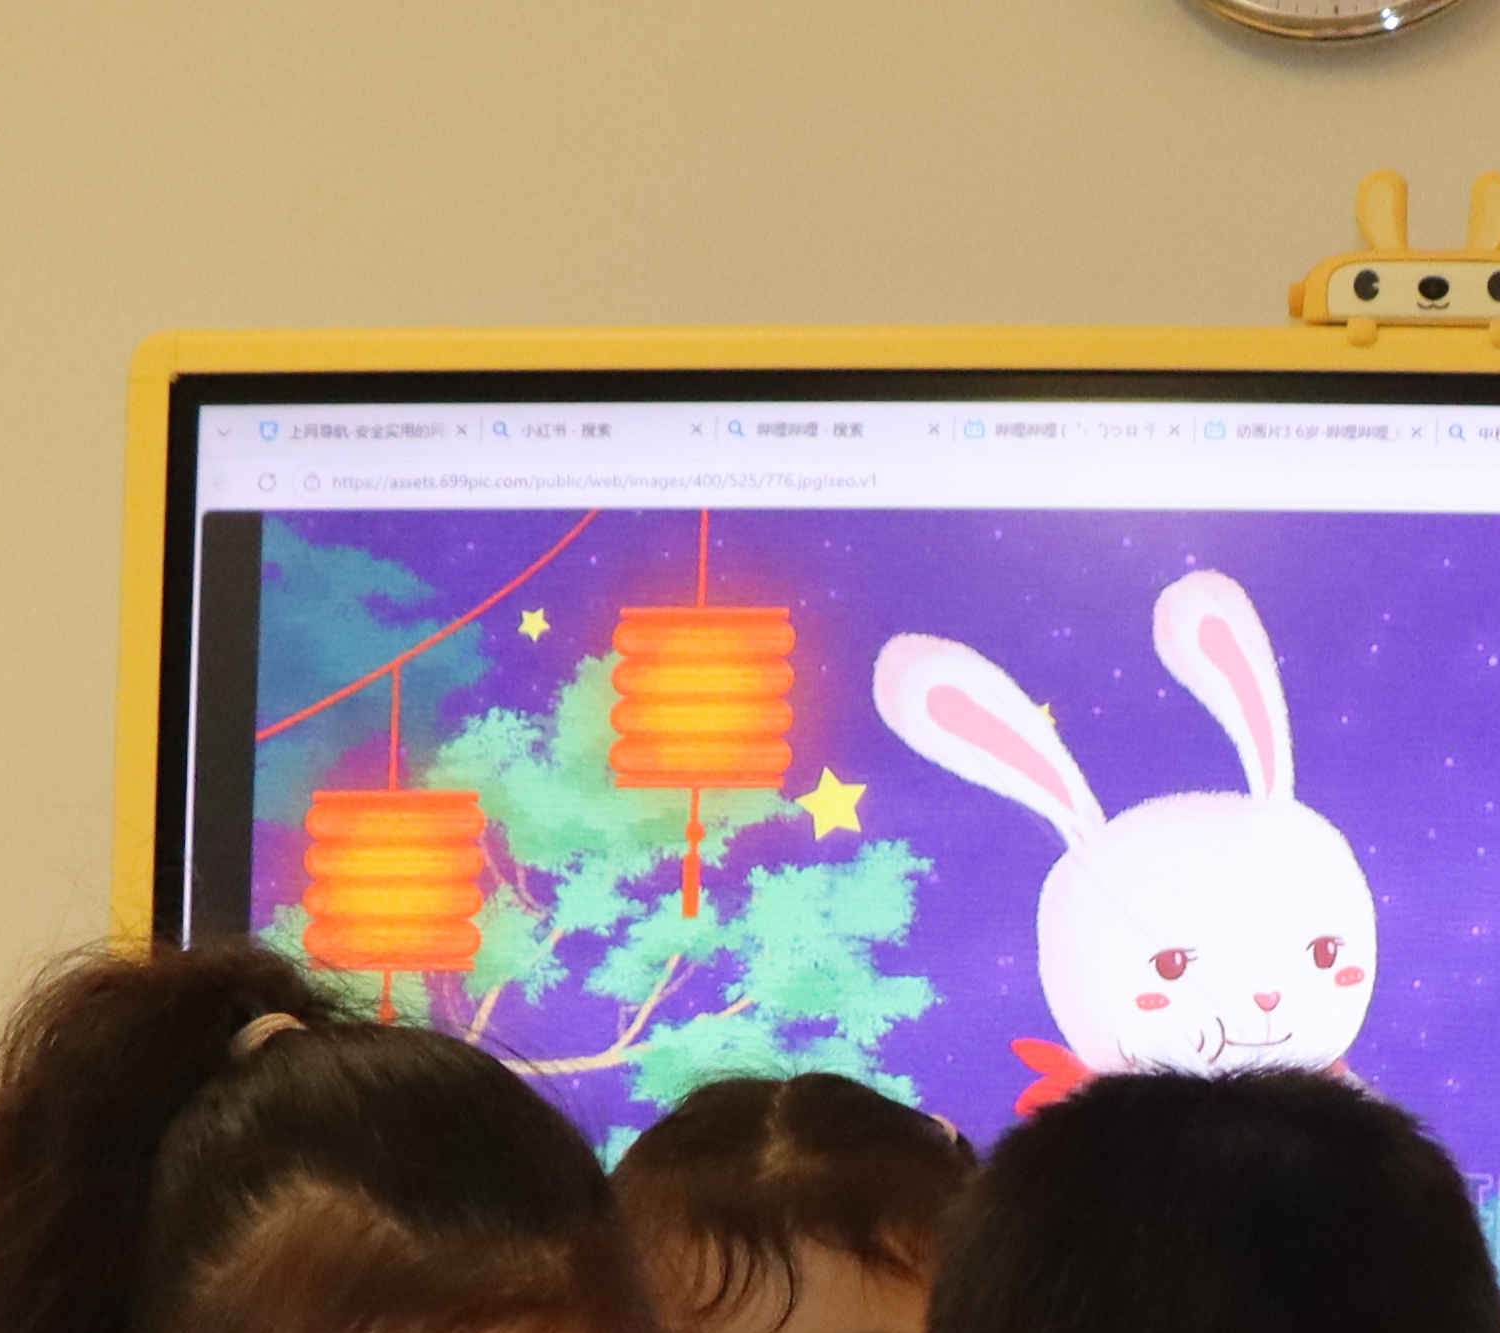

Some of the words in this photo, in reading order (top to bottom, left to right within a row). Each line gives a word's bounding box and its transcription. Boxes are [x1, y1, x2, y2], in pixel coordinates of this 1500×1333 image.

[520, 423, 568, 439] 小红书
[581, 423, 612, 438] 搜索
[832, 422, 864, 438] 搜索
